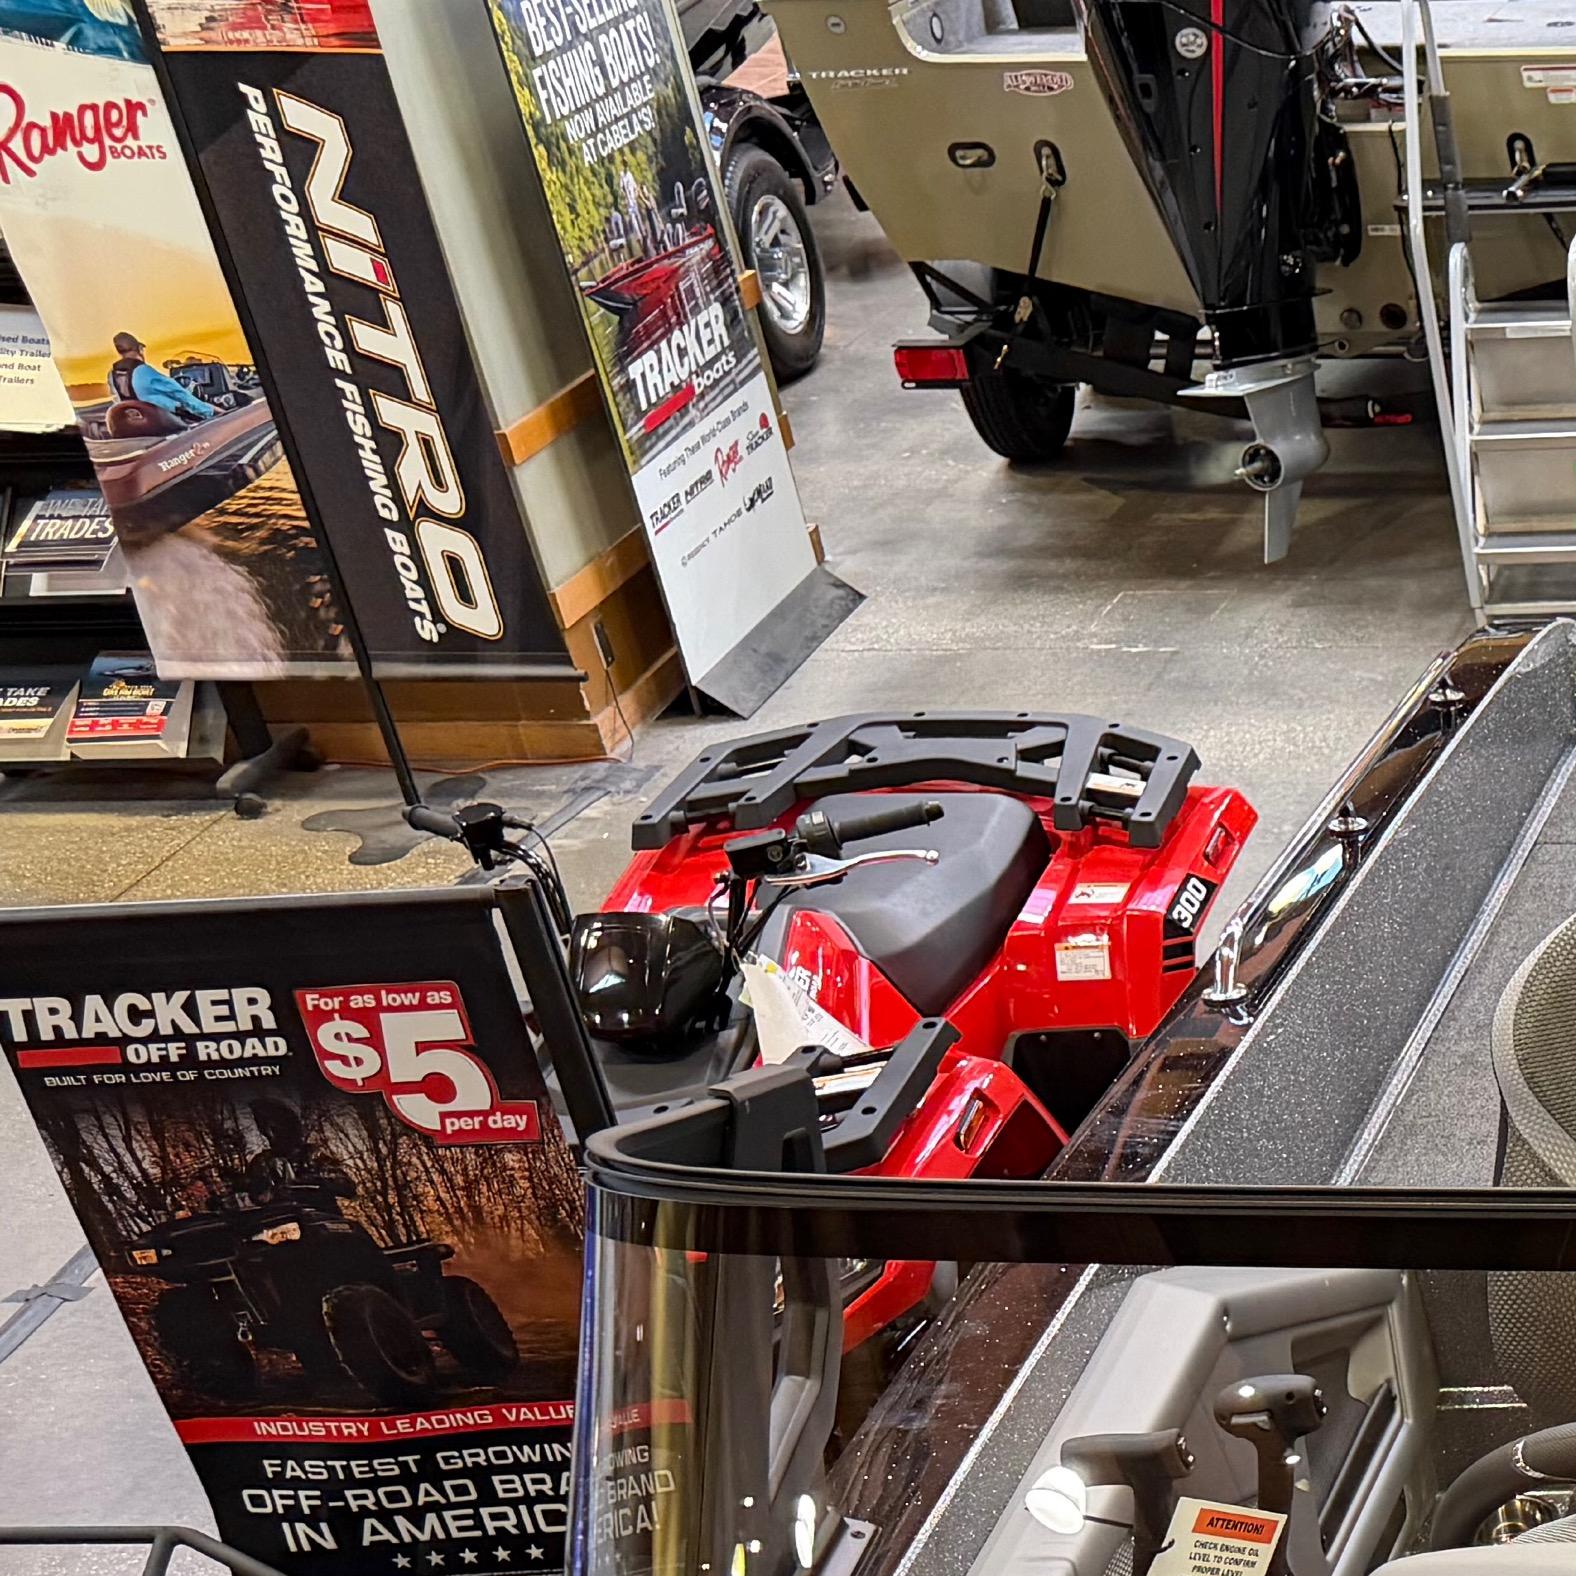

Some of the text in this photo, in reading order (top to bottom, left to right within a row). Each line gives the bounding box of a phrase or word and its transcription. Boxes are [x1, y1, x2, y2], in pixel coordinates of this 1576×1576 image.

[532, 12, 661, 124] FISHING BOATS!
[808, 67, 909, 79] TRACKER
[565, 75, 655, 144] NOW AVAILABLE
[0, 83, 148, 185] Ranger
[582, 105, 656, 167] AT CABELA'S!
[108, 145, 168, 160] BOATS
[0, 335, 19, 344] sed
[628, 302, 731, 411] TRACKER
[17, 362, 41, 372] Boat
[237, 82, 440, 643] PERFORMANCE FISHING BOATS
[272, 88, 503, 640] NITRO
[691, 351, 737, 395] boats
[658, 452, 686, 480] Featuring
[684, 442, 701, 461] These
[729, 401, 750, 424] Brands
[649, 492, 683, 529] TRACKER
[684, 469, 714, 504] NITRO
[29, 517, 116, 541] TRADES
[711, 507, 744, 539] TAHOE
[7, 687, 50, 697] TAKE
[1171, 877, 1207, 928] 300
[0, 987, 278, 1042] TRACKER
[305, 990, 452, 1011] For as low as
[126, 1036, 288, 1064] OFF ROAD
[44, 1065, 281, 1087] BUILT FOR LOVE OF COUNTRY
[316, 1009, 492, 1130] $5
[445, 1111, 528, 1134] per day
[253, 1421, 369, 1436] INDUSTRY
[380, 1409, 493, 1434] LEADING
[262, 1442, 572, 1480] FASTEST GROWIN
[241, 1471, 571, 1515] OFF-ROAD BRA
[281, 1503, 569, 1552] IN AMERIC
[1206, 1516, 1264, 1535] ATTENTION!
[1189, 1552, 1257, 1568] LEVEL TO CONFIRM
[1193, 1540, 1259, 1557] CHECK ENGINE OIL
[1191, 1565, 1220, 1575] PROPER
